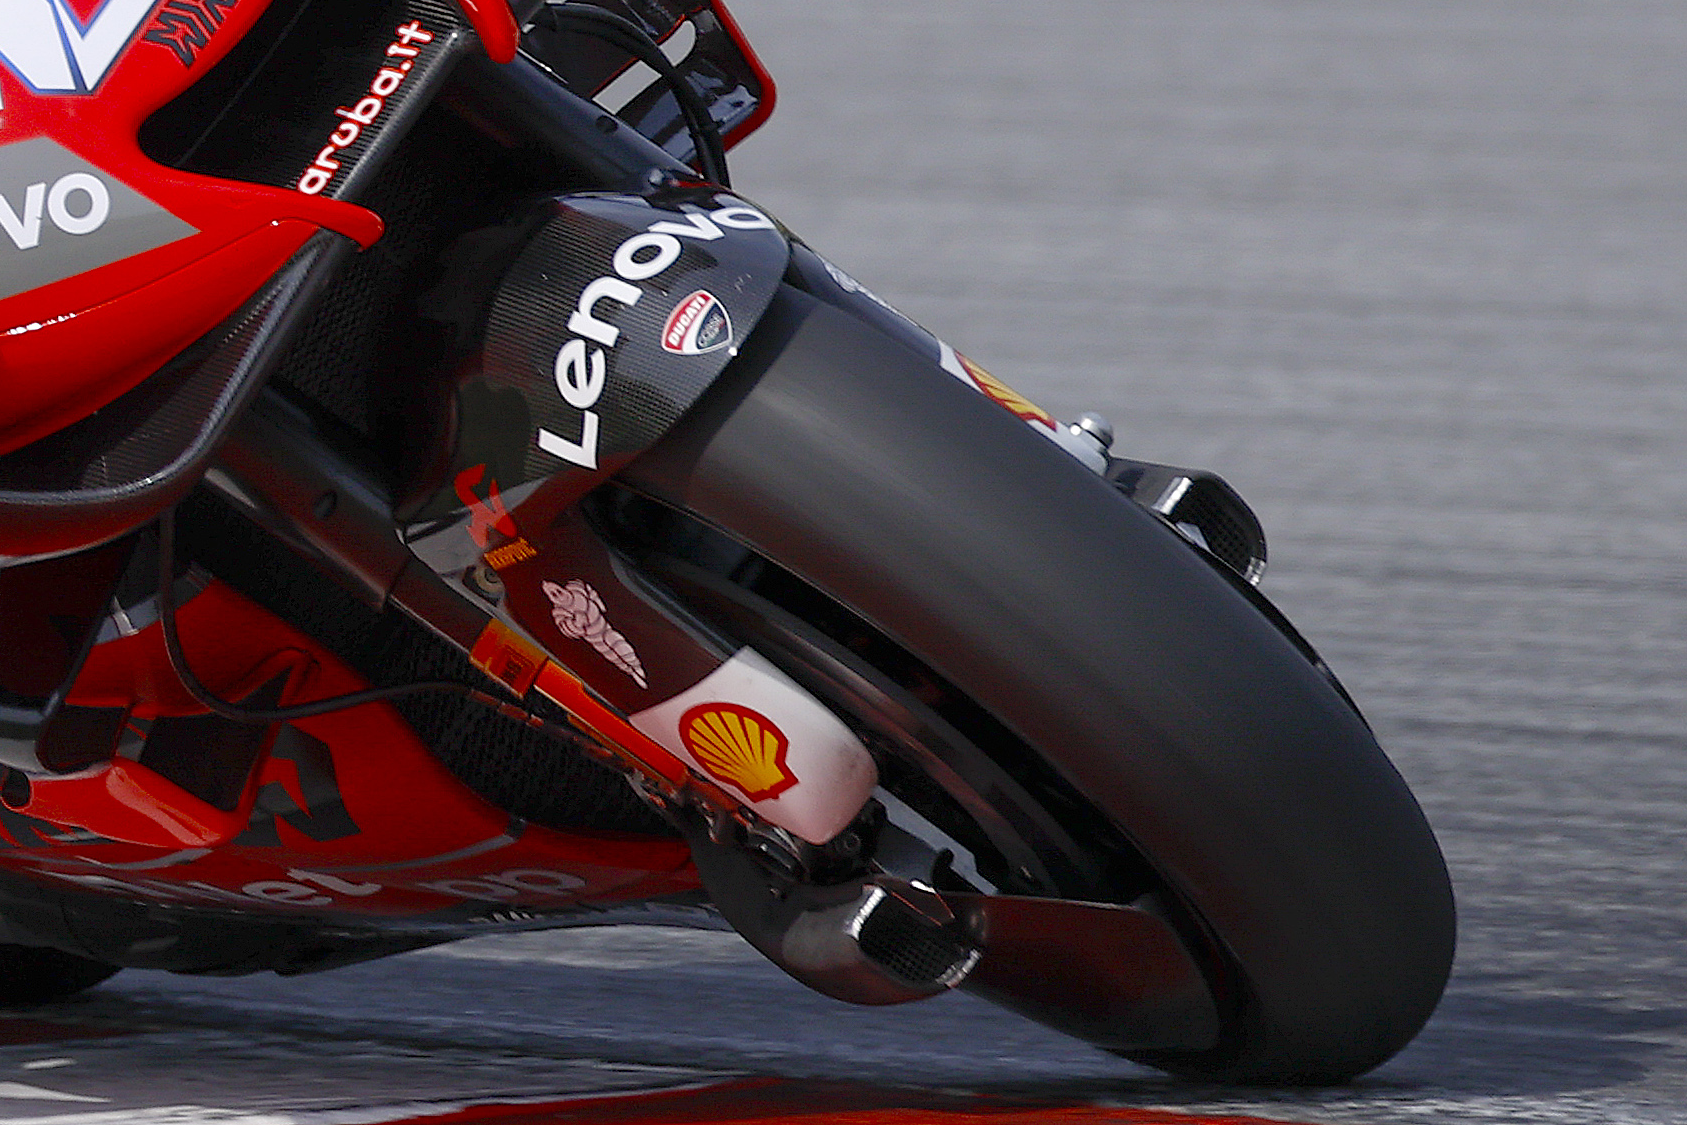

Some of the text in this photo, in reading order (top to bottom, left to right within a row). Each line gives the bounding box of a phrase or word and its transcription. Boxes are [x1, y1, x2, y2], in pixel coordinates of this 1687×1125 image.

[298, 21, 433, 195] aruba.it
[536, 202, 774, 471] Lenovo
[667, 295, 706, 347] DUCATI
